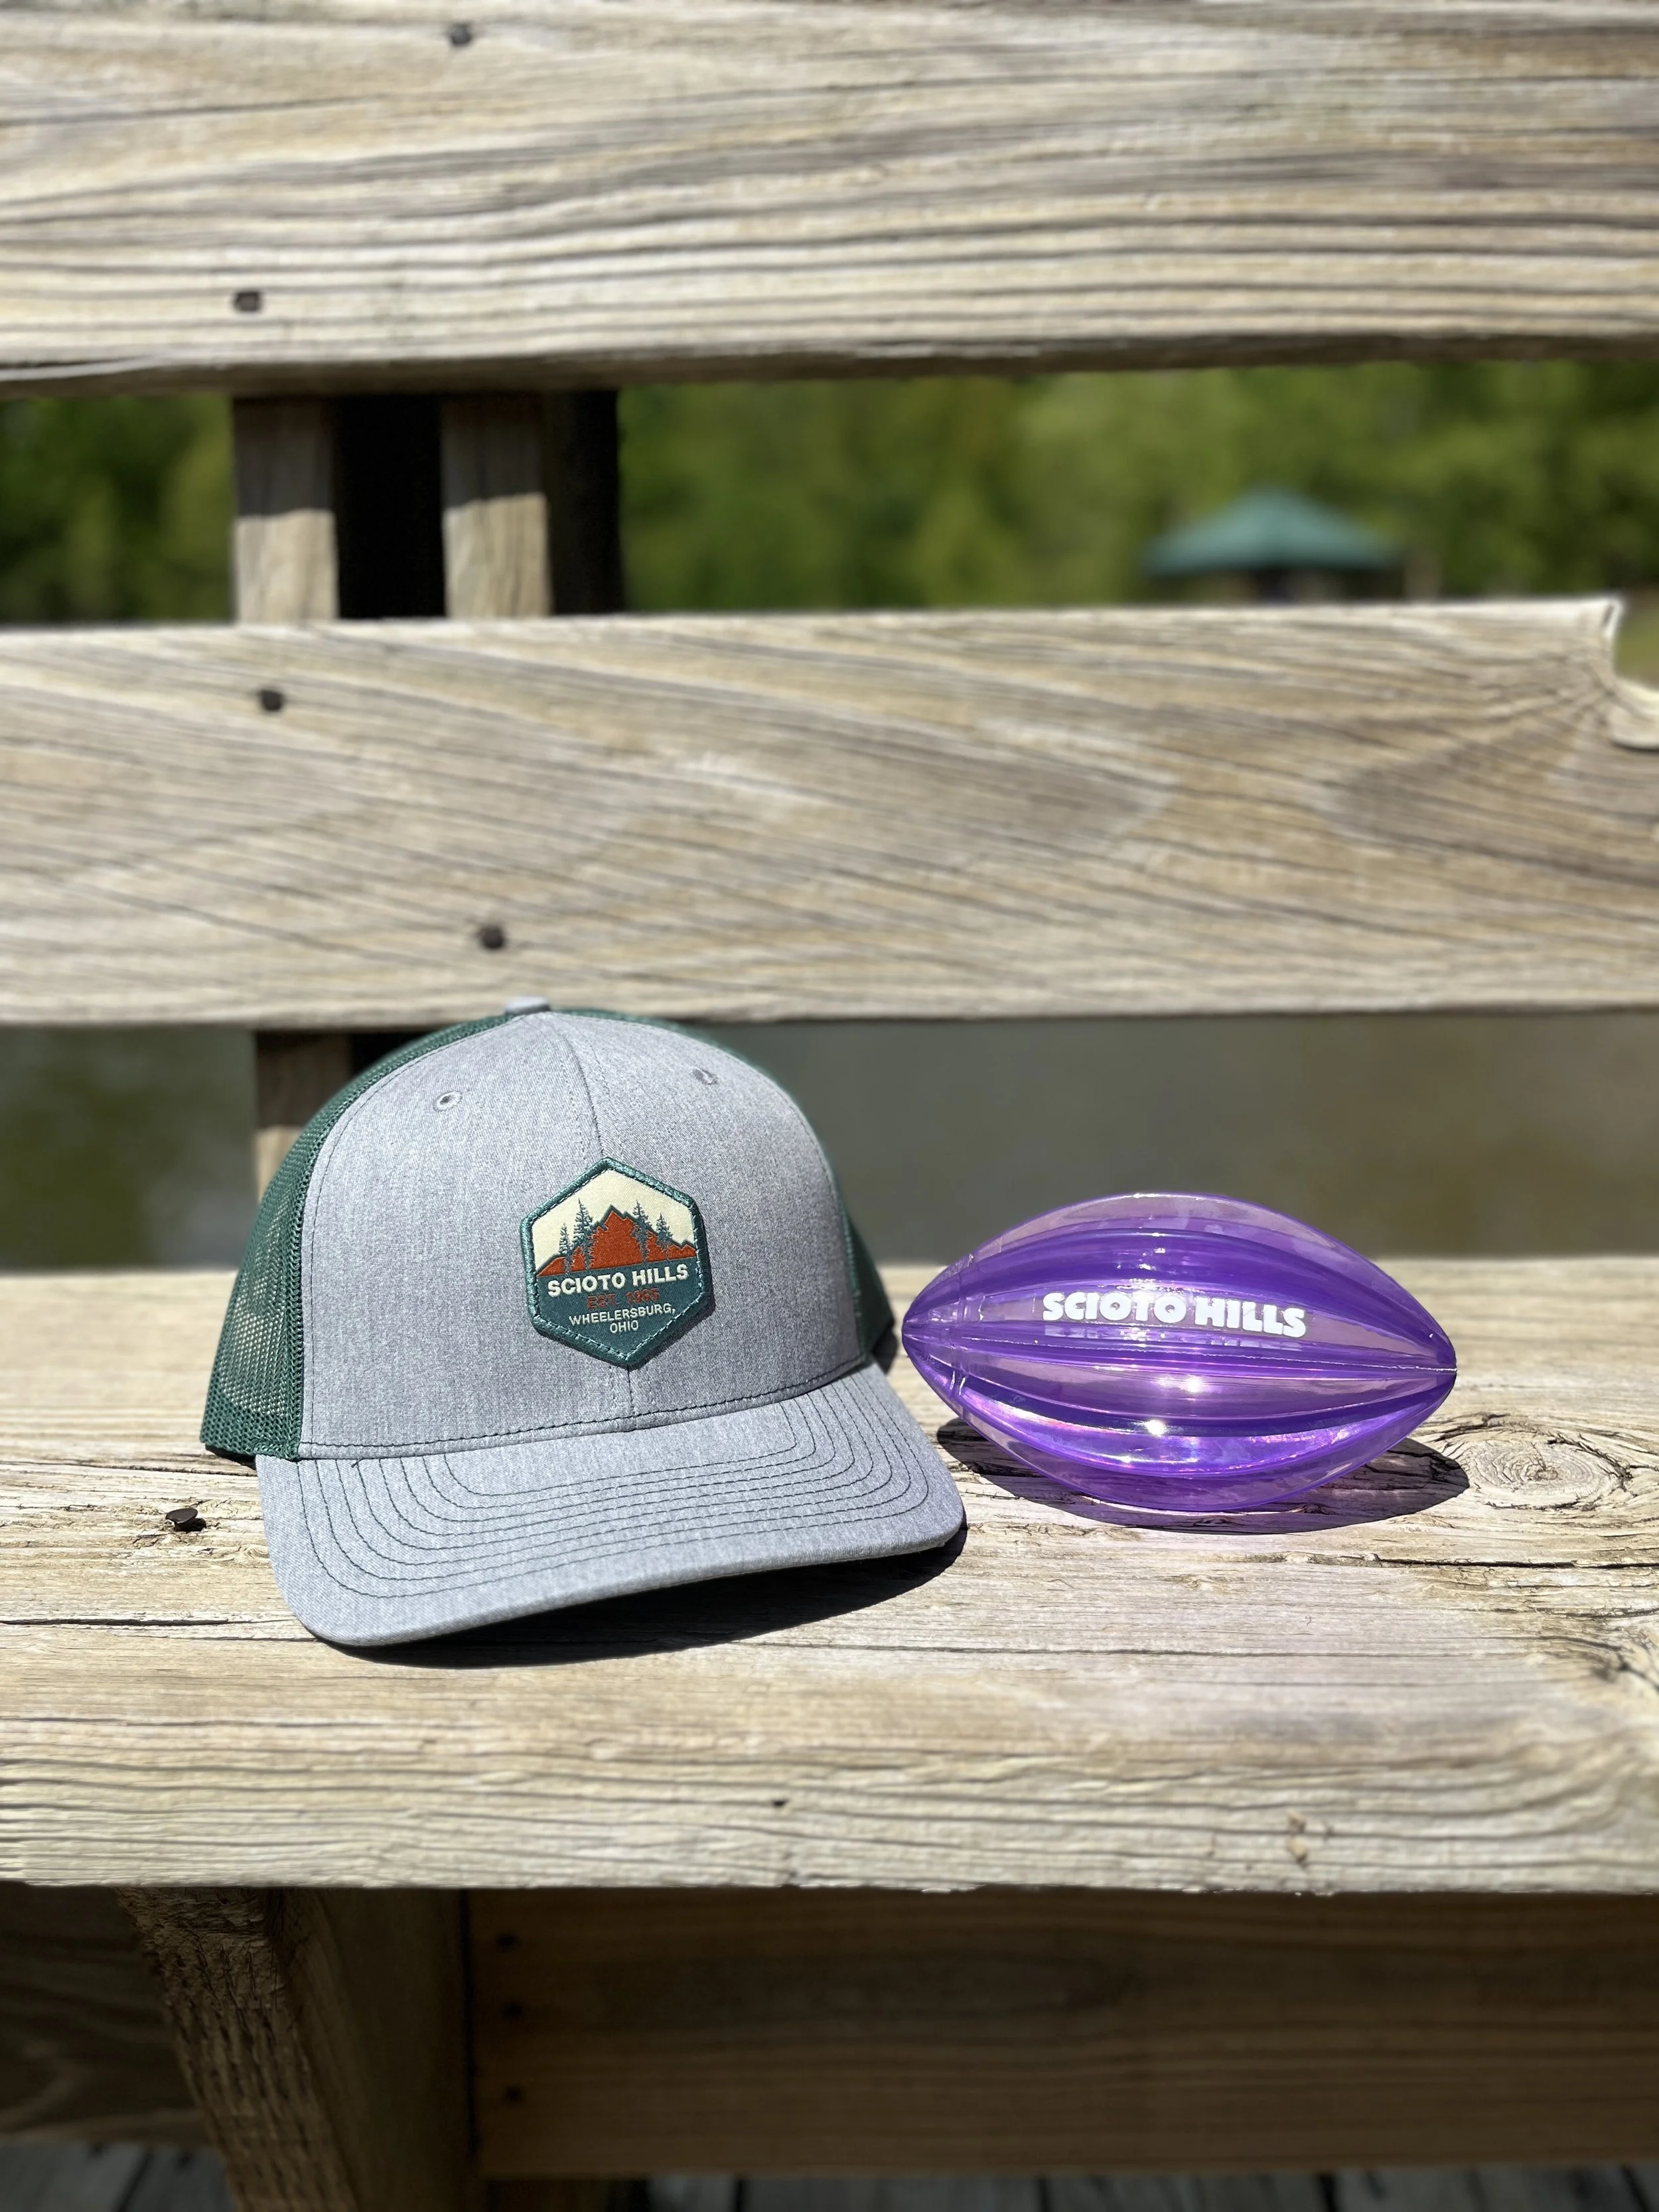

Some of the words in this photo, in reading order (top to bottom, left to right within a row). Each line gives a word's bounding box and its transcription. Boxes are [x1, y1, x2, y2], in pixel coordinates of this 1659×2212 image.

[547, 1272, 626, 1297] SCIOTO
[632, 1264, 689, 1284] HILLS
[626, 1288, 660, 1304] 1965
[569, 1303, 676, 1326] WHEELERSBURG,
[1043, 1291, 1187, 1323] SCIOTO
[1194, 1296, 1307, 1338] HILLS
[610, 1320, 638, 1334] OHIO
